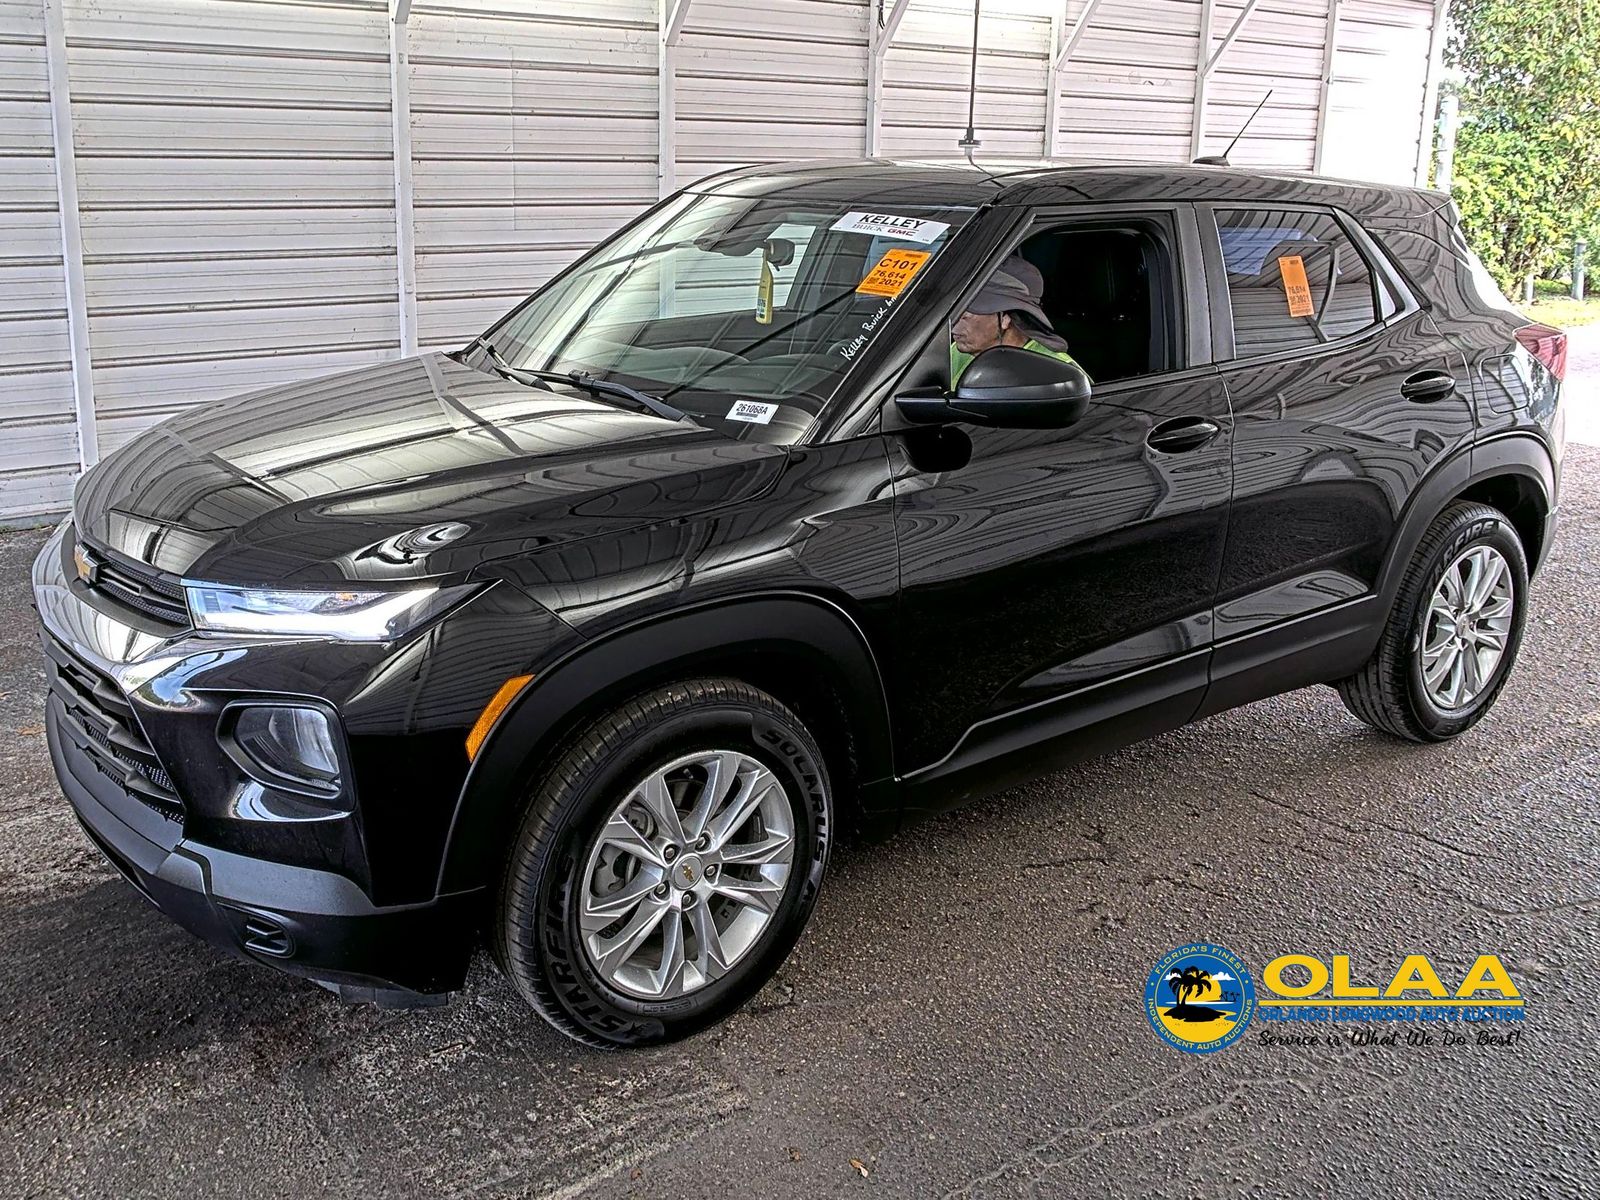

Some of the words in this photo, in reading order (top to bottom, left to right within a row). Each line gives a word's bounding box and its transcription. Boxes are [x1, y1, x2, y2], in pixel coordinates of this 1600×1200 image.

[860, 214, 927, 229] KELLEY
[852, 223, 883, 232] BUICK
[887, 228, 916, 237] GMC
[880, 258, 918, 271] C101
[879, 278, 904, 287] 2021
[736, 403, 769, 415] 261068A
[760, 730, 826, 864] SOLARUS
[546, 854, 628, 1033] STARFIRE
